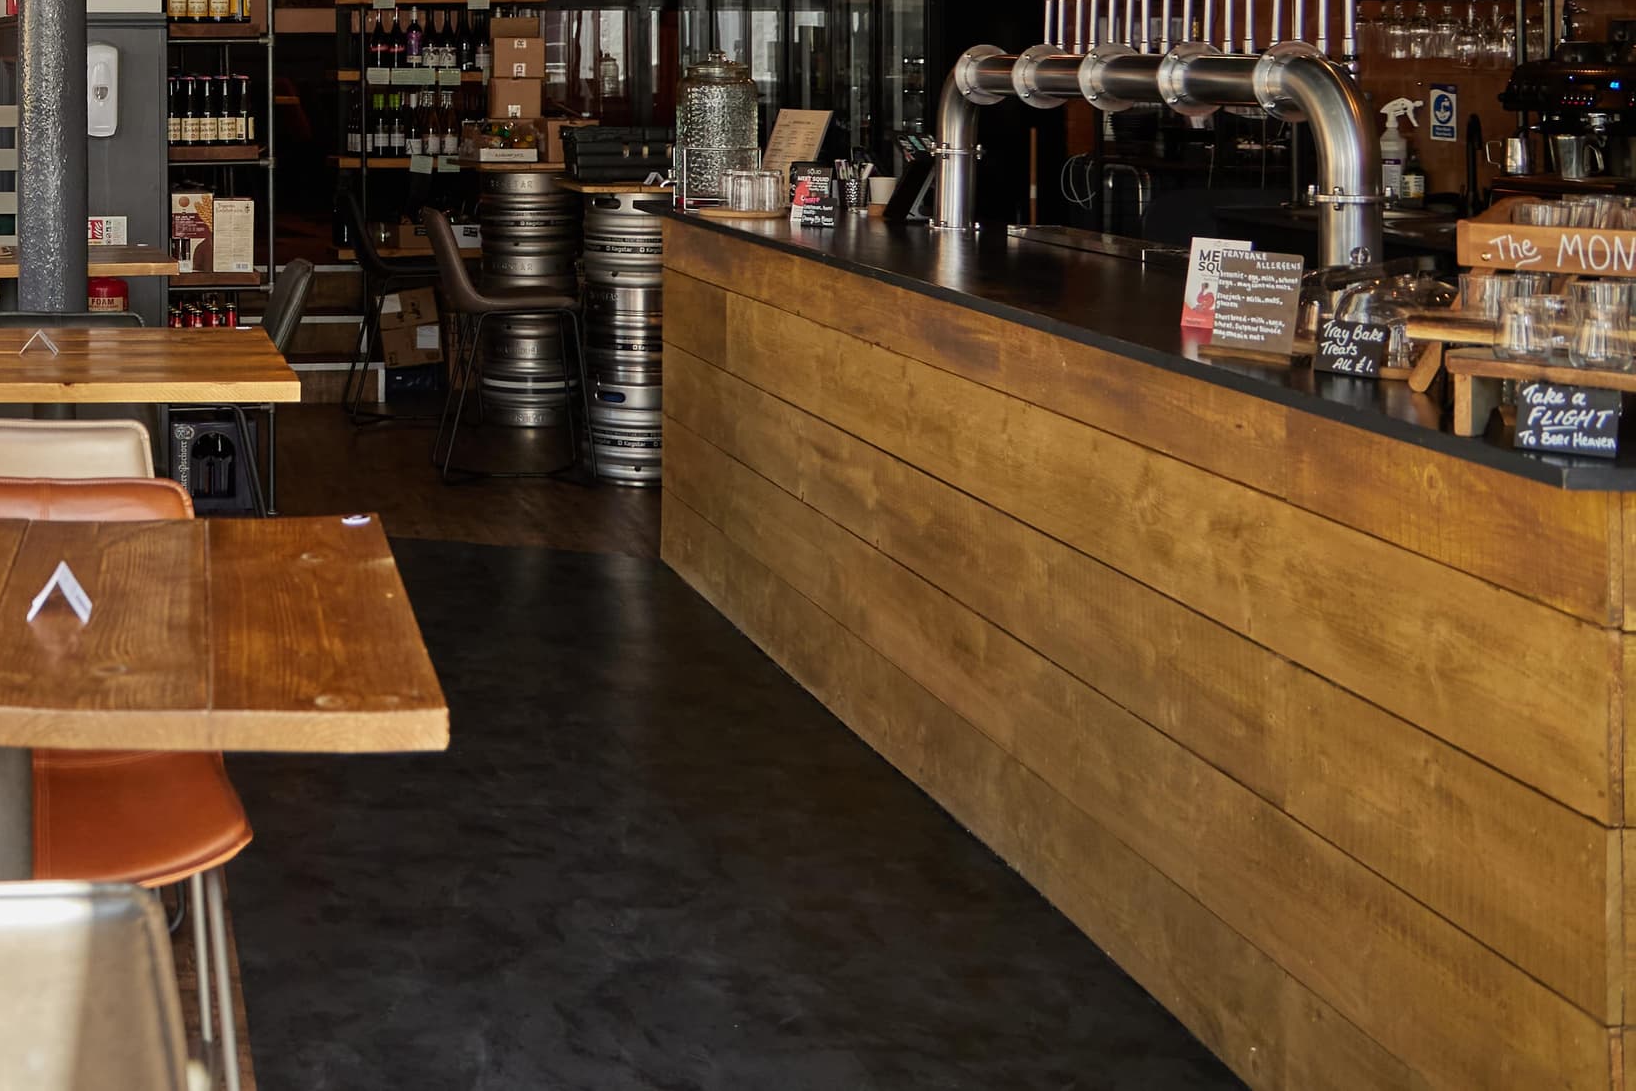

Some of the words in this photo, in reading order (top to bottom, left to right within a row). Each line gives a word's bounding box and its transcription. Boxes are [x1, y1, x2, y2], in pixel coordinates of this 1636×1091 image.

[1222, 249, 1268, 261] TRAYBAKE
[1488, 233, 1538, 261] The
[1199, 250, 1221, 263] ME
[1255, 261, 1302, 271] ALLERGENS
[91, 298, 115, 306] FOAM
[1323, 319, 1350, 346] Tray
[1352, 324, 1384, 343] Bake
[1320, 340, 1358, 356] Treats
[1522, 383, 1566, 404] Take
[1571, 392, 1587, 406] a
[1527, 405, 1614, 429] FLIGHT
[1518, 430, 1537, 446] To
[1541, 432, 1571, 446] Beer
[1572, 432, 1617, 449] Heaven
